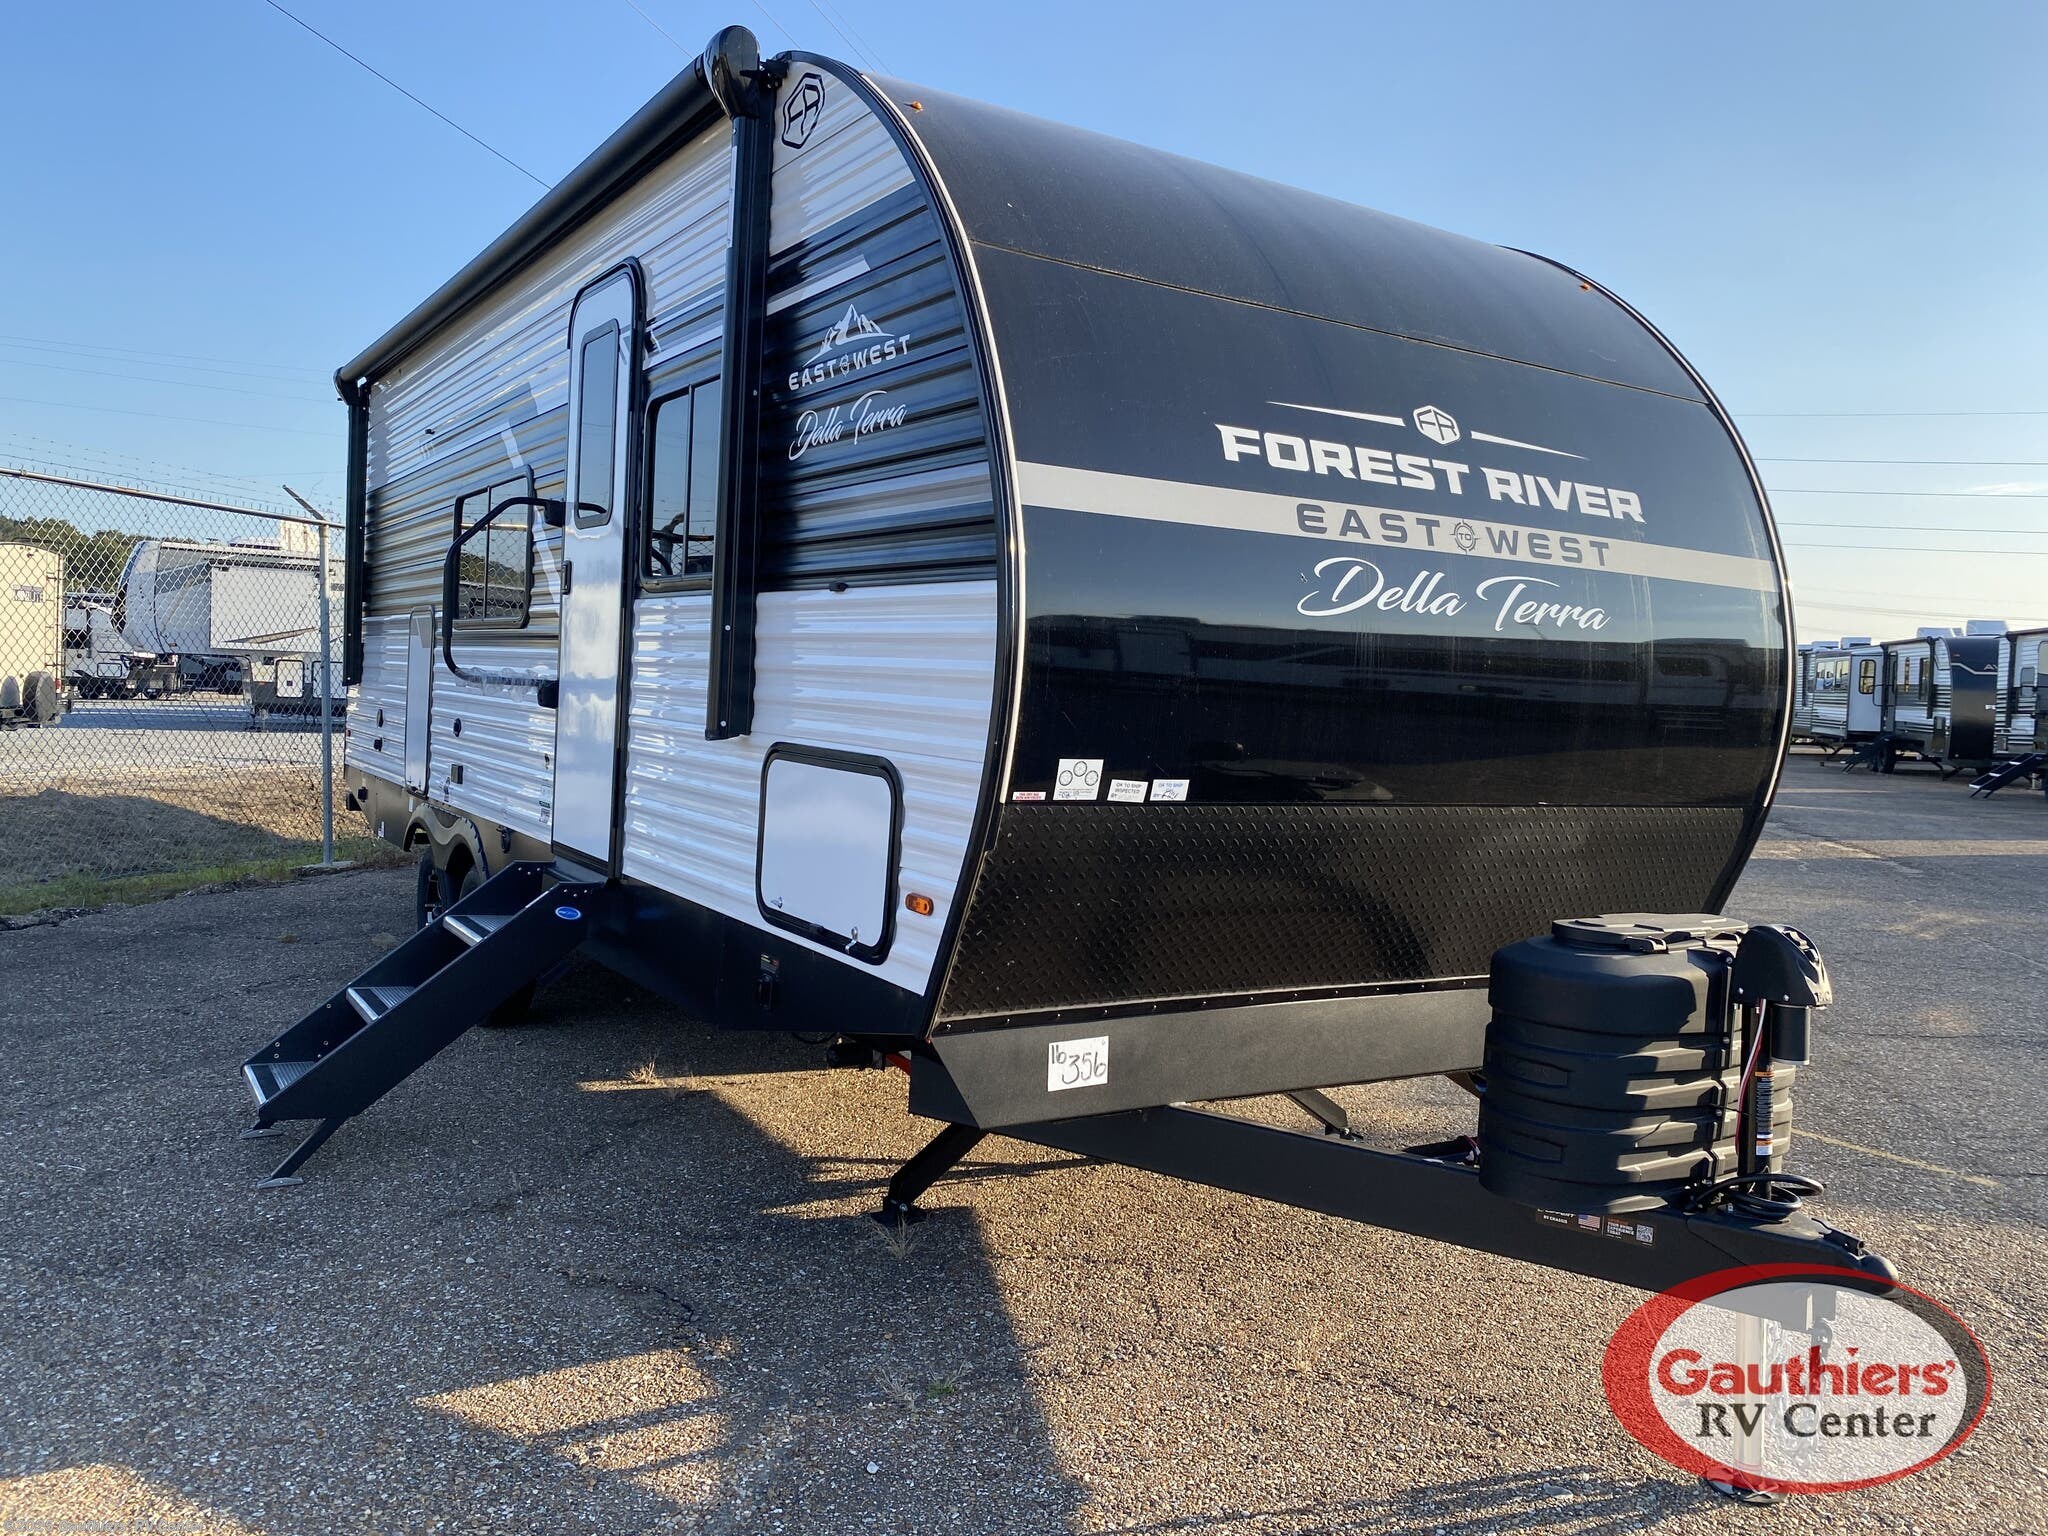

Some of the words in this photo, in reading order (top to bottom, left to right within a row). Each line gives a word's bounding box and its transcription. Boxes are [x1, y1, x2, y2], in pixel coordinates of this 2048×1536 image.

[788, 359, 837, 391] EAST
[853, 334, 910, 370] WEST
[788, 406, 844, 460] Della
[850, 390, 907, 445] Terra
[1215, 424, 1470, 495] FOREST
[1481, 467, 1647, 525] RIVER
[1296, 503, 1440, 547] EAST
[1485, 526, 1610, 567] WEST
[1297, 557, 1467, 617] Della
[1476, 576, 1612, 632] Terra
